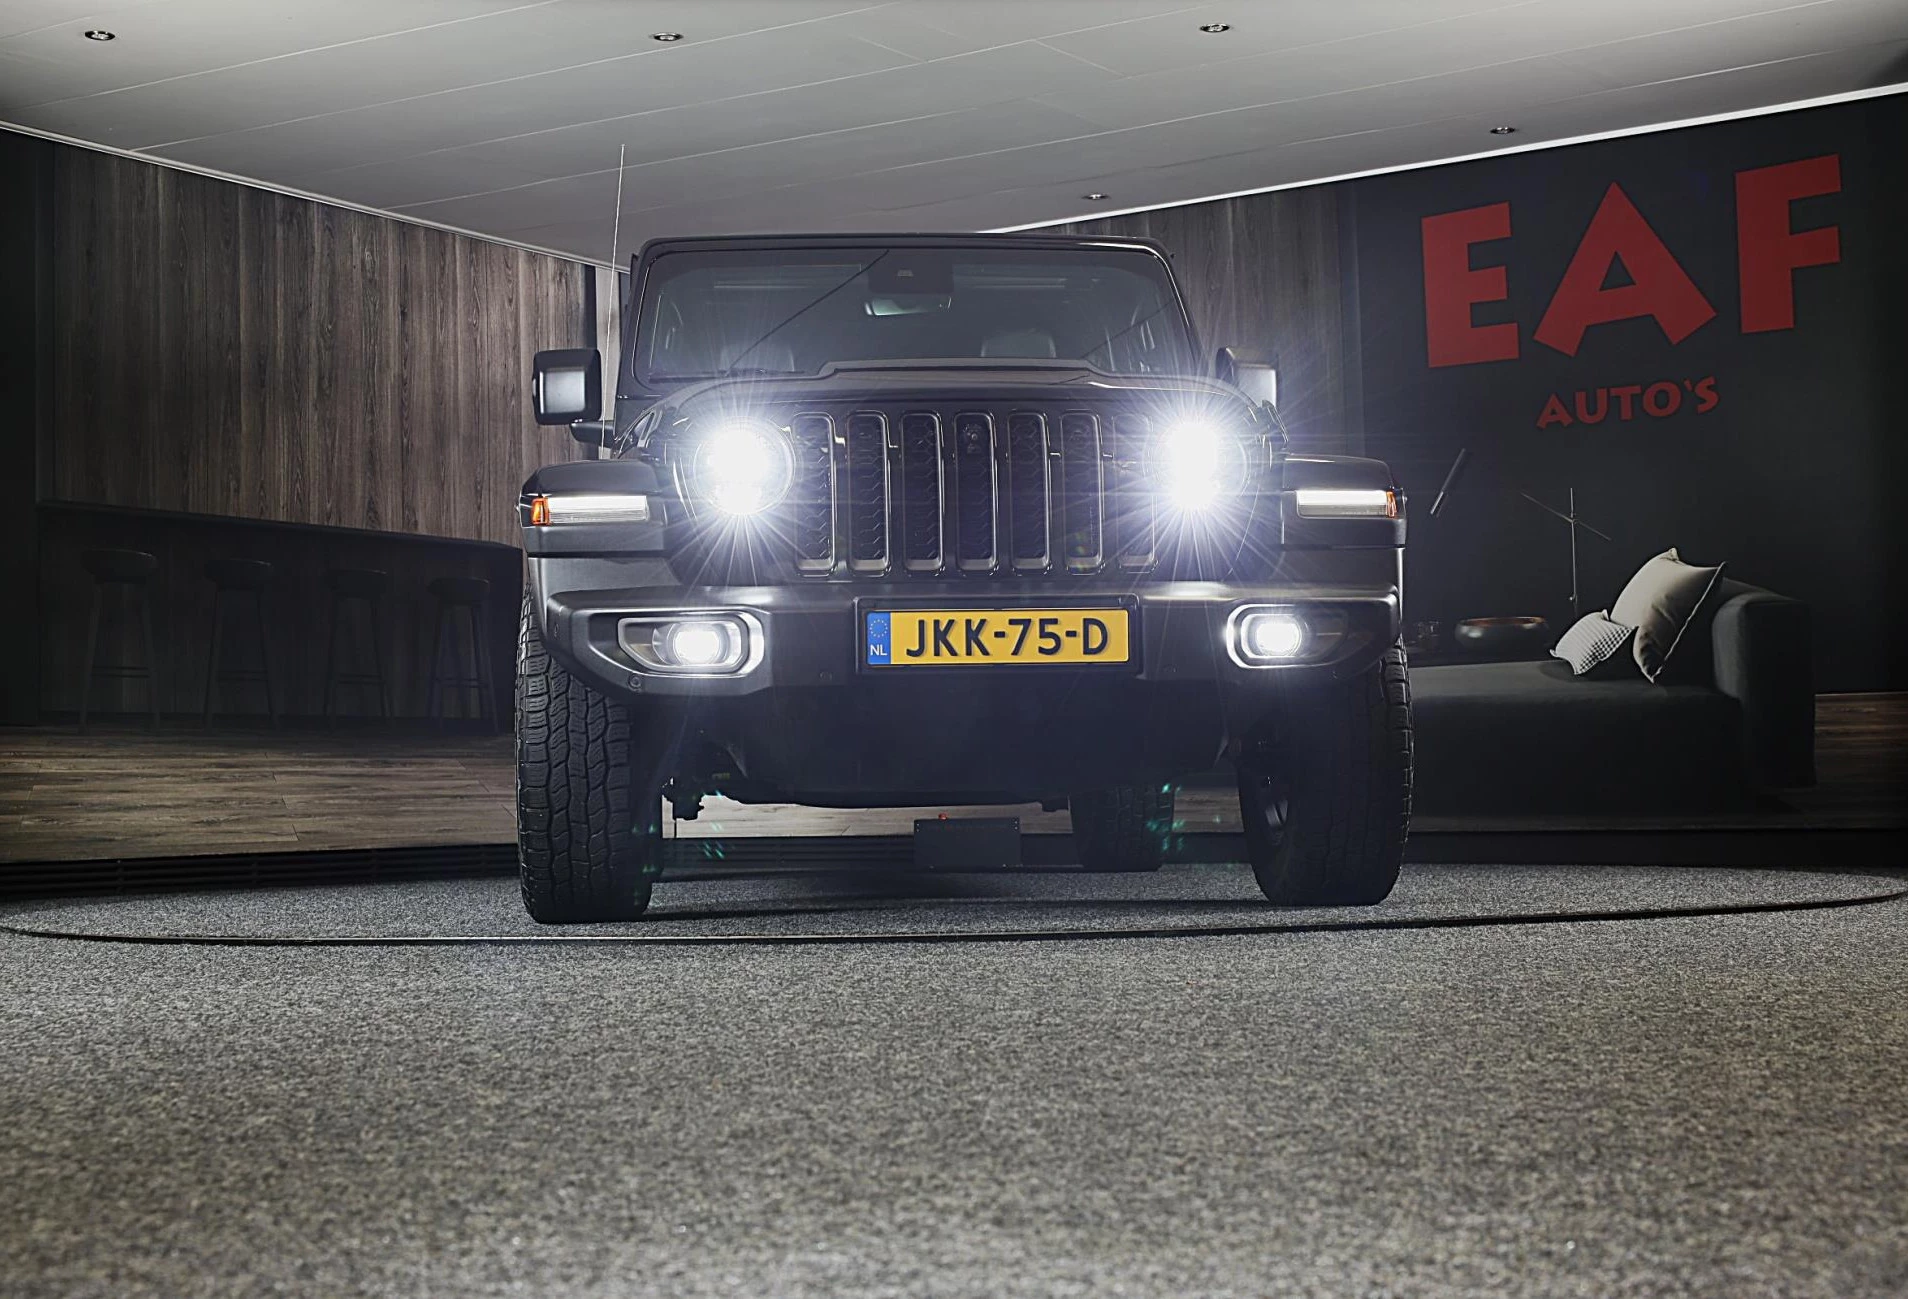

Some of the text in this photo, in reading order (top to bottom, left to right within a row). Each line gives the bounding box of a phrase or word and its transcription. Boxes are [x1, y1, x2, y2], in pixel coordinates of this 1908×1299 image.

[1421, 154, 1841, 368] EAF
[1536, 376, 1719, 429] AUTO'S
[869, 644, 888, 656] NL
[906, 618, 1108, 657] JKK-75-D
